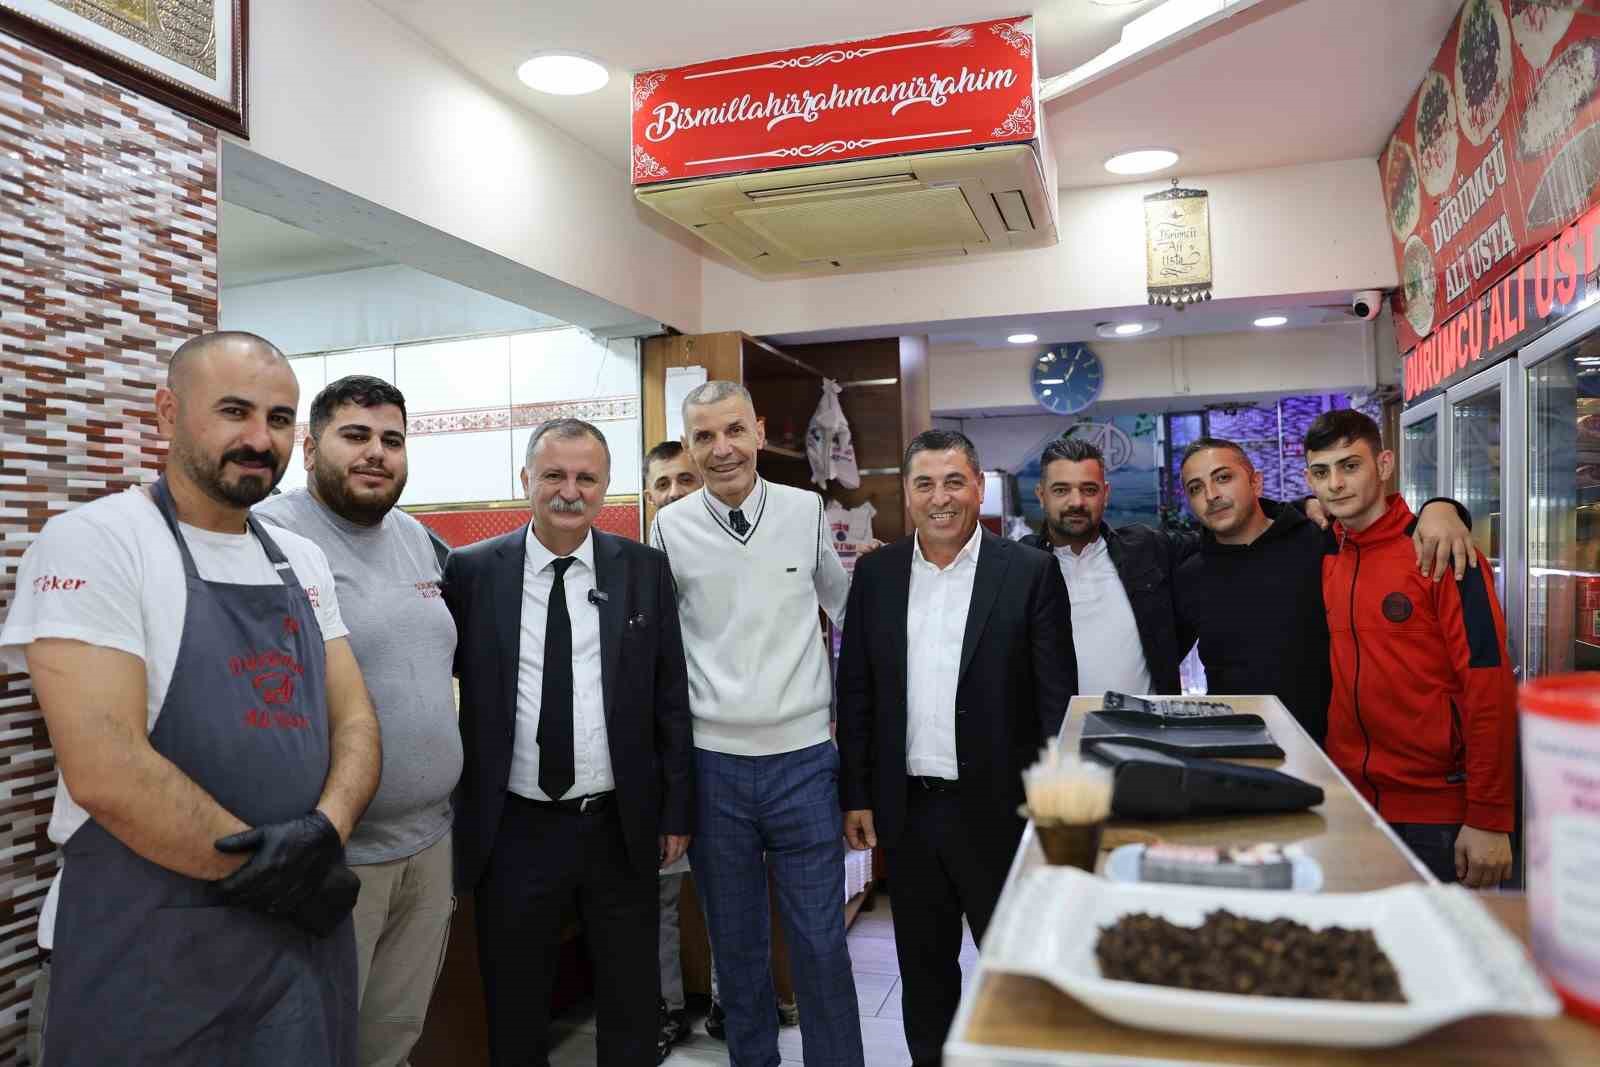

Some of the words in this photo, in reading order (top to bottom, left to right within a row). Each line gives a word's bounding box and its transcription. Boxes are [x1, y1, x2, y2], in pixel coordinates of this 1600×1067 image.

[644, 66, 1016, 142] Bismillahirrahmanirrahim
[1431, 128, 1507, 253] DÜRÜMCÜ
[1469, 213, 1517, 280] USTA
